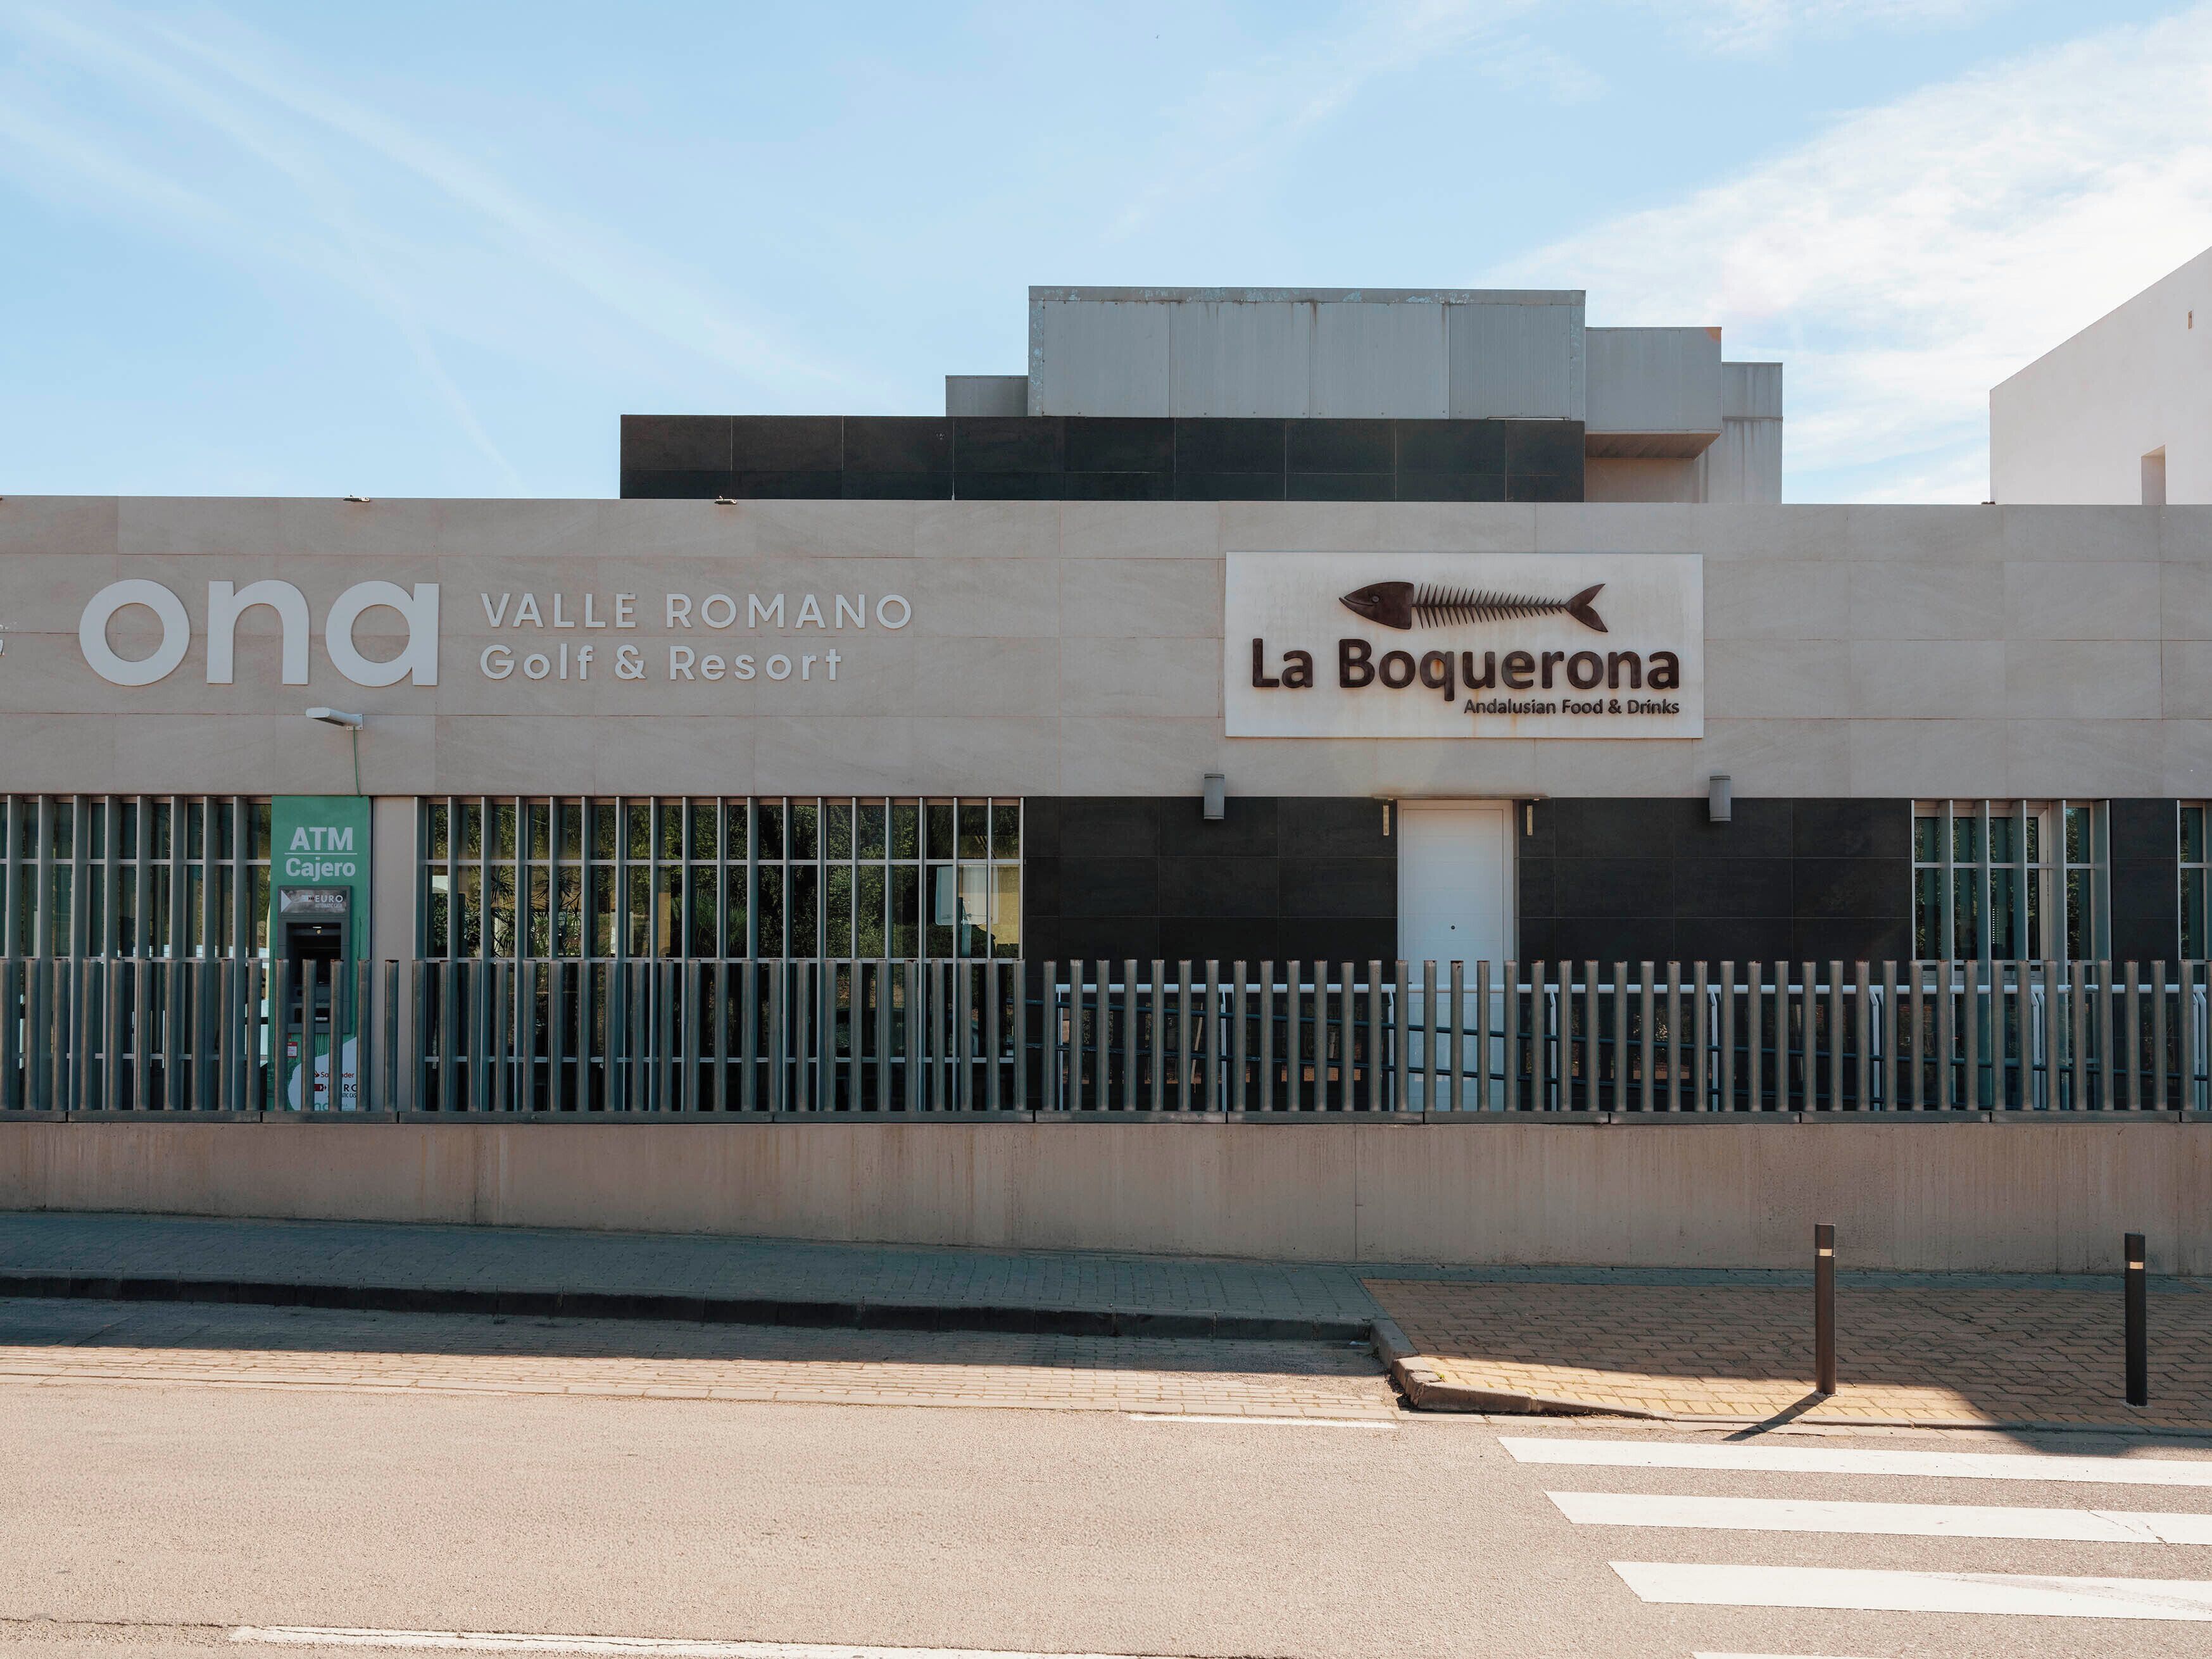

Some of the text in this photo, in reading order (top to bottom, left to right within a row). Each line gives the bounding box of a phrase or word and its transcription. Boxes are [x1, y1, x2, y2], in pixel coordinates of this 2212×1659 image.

[481, 592, 912, 629] VALLE ROMANO
[79, 579, 439, 687] ona
[480, 643, 841, 680] Golf & Resort
[1252, 638, 1679, 701] La Boquerona
[1464, 698, 1679, 714] Andalusian Food & Drinks
[290, 827, 353, 851] ATM
[286, 856, 356, 882] Cajero
